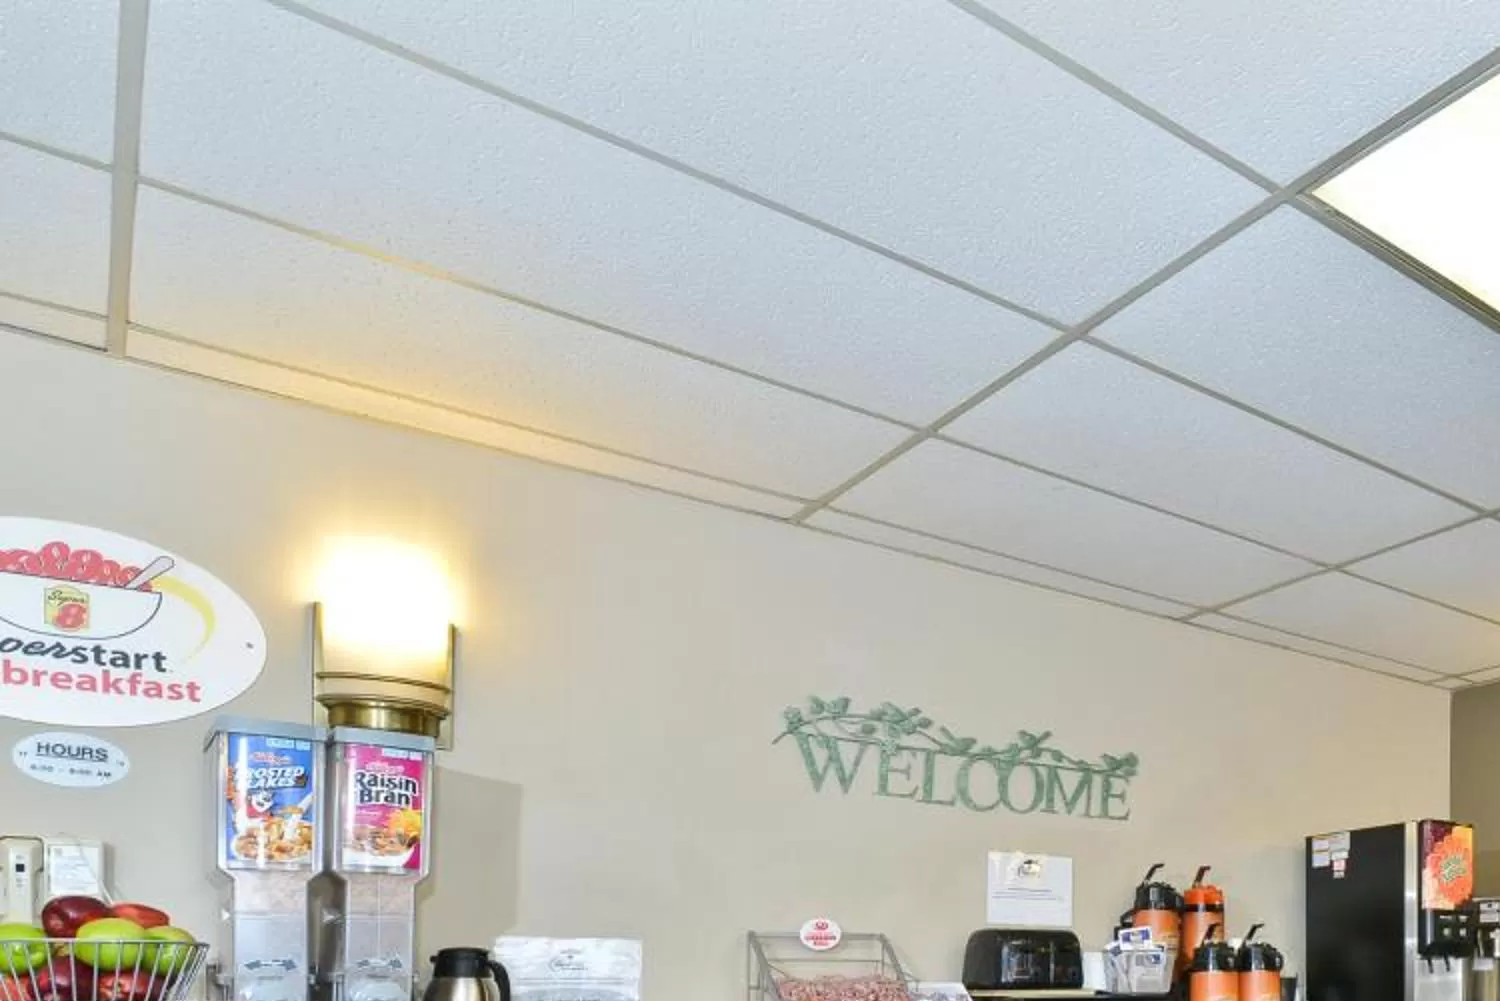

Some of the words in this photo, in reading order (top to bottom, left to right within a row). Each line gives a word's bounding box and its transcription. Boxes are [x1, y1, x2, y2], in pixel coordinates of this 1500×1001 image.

[2, 658, 201, 703] breakfast
[36, 742, 109, 762] HOURS
[355, 771, 417, 795] Raisin
[793, 733, 1133, 822] WELCOME
[359, 788, 410, 806] Bran
